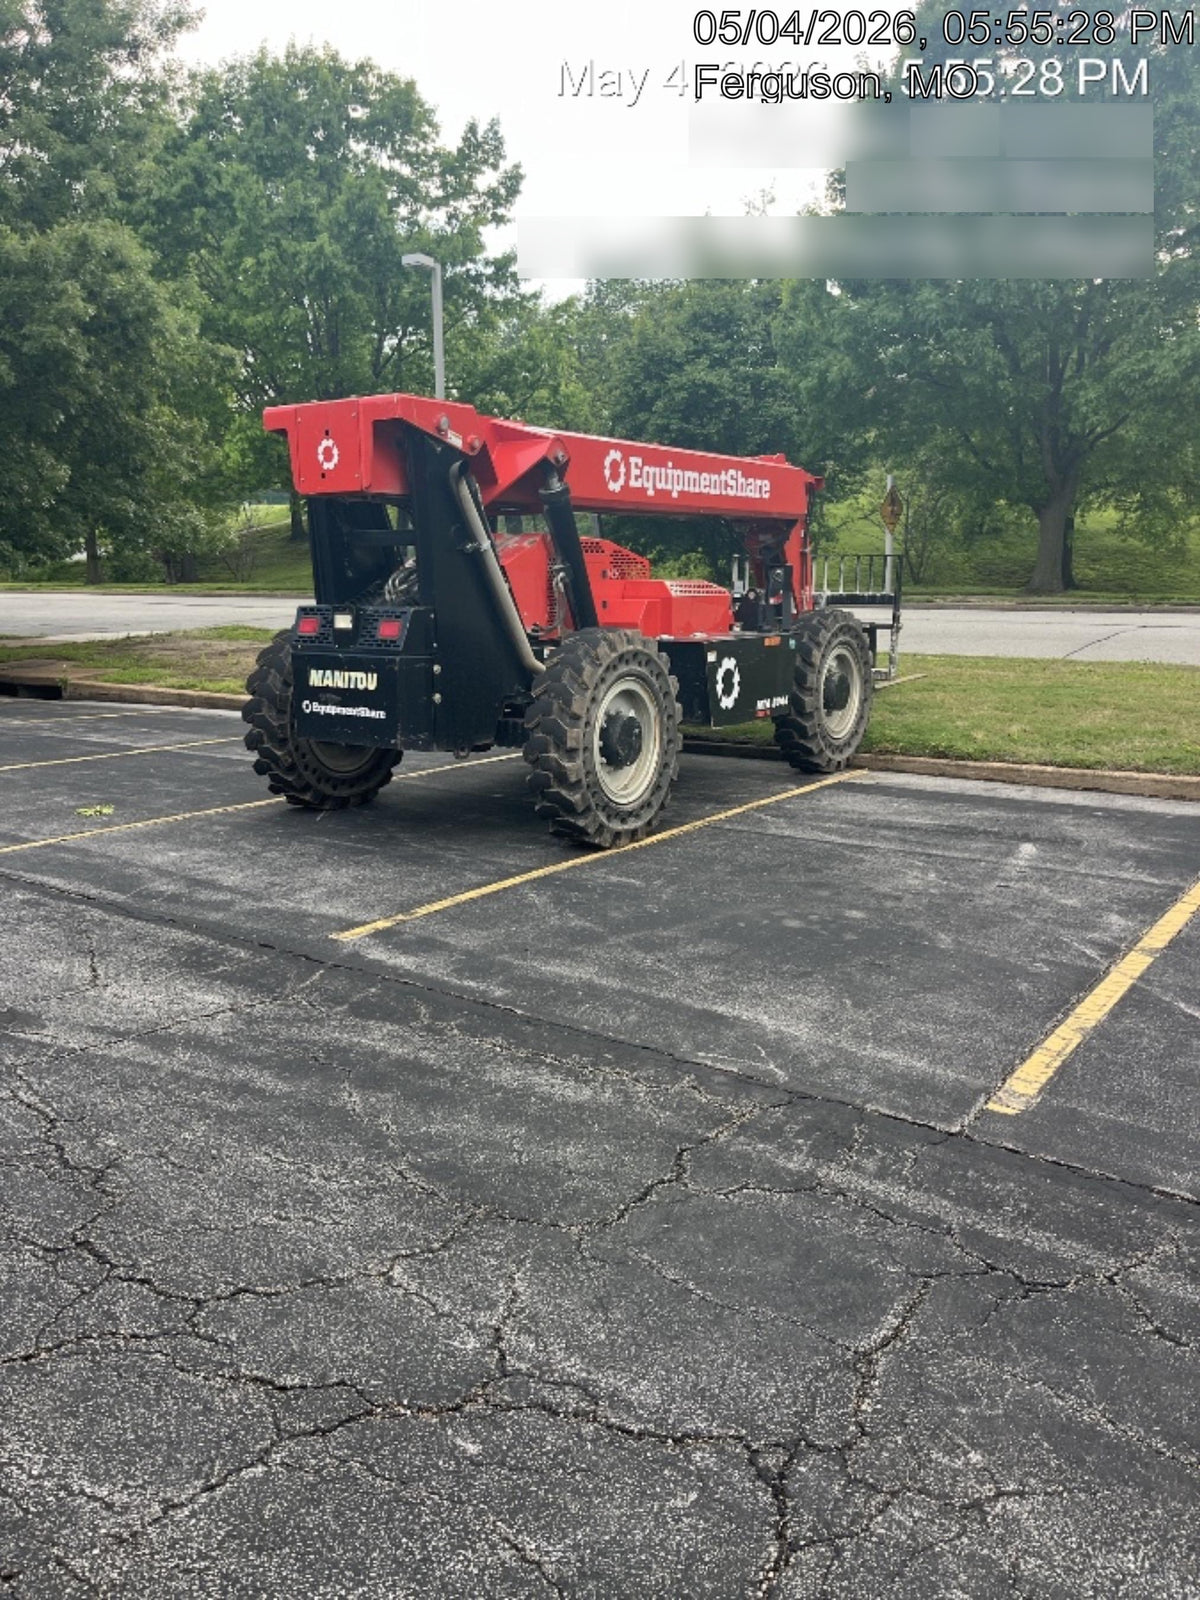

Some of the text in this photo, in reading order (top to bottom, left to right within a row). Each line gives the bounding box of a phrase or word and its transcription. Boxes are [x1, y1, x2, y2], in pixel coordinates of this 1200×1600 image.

[628, 456, 771, 499] EquipmentShare
[308, 669, 378, 691] MANITOU
[312, 701, 387, 719] EquipmentShare
